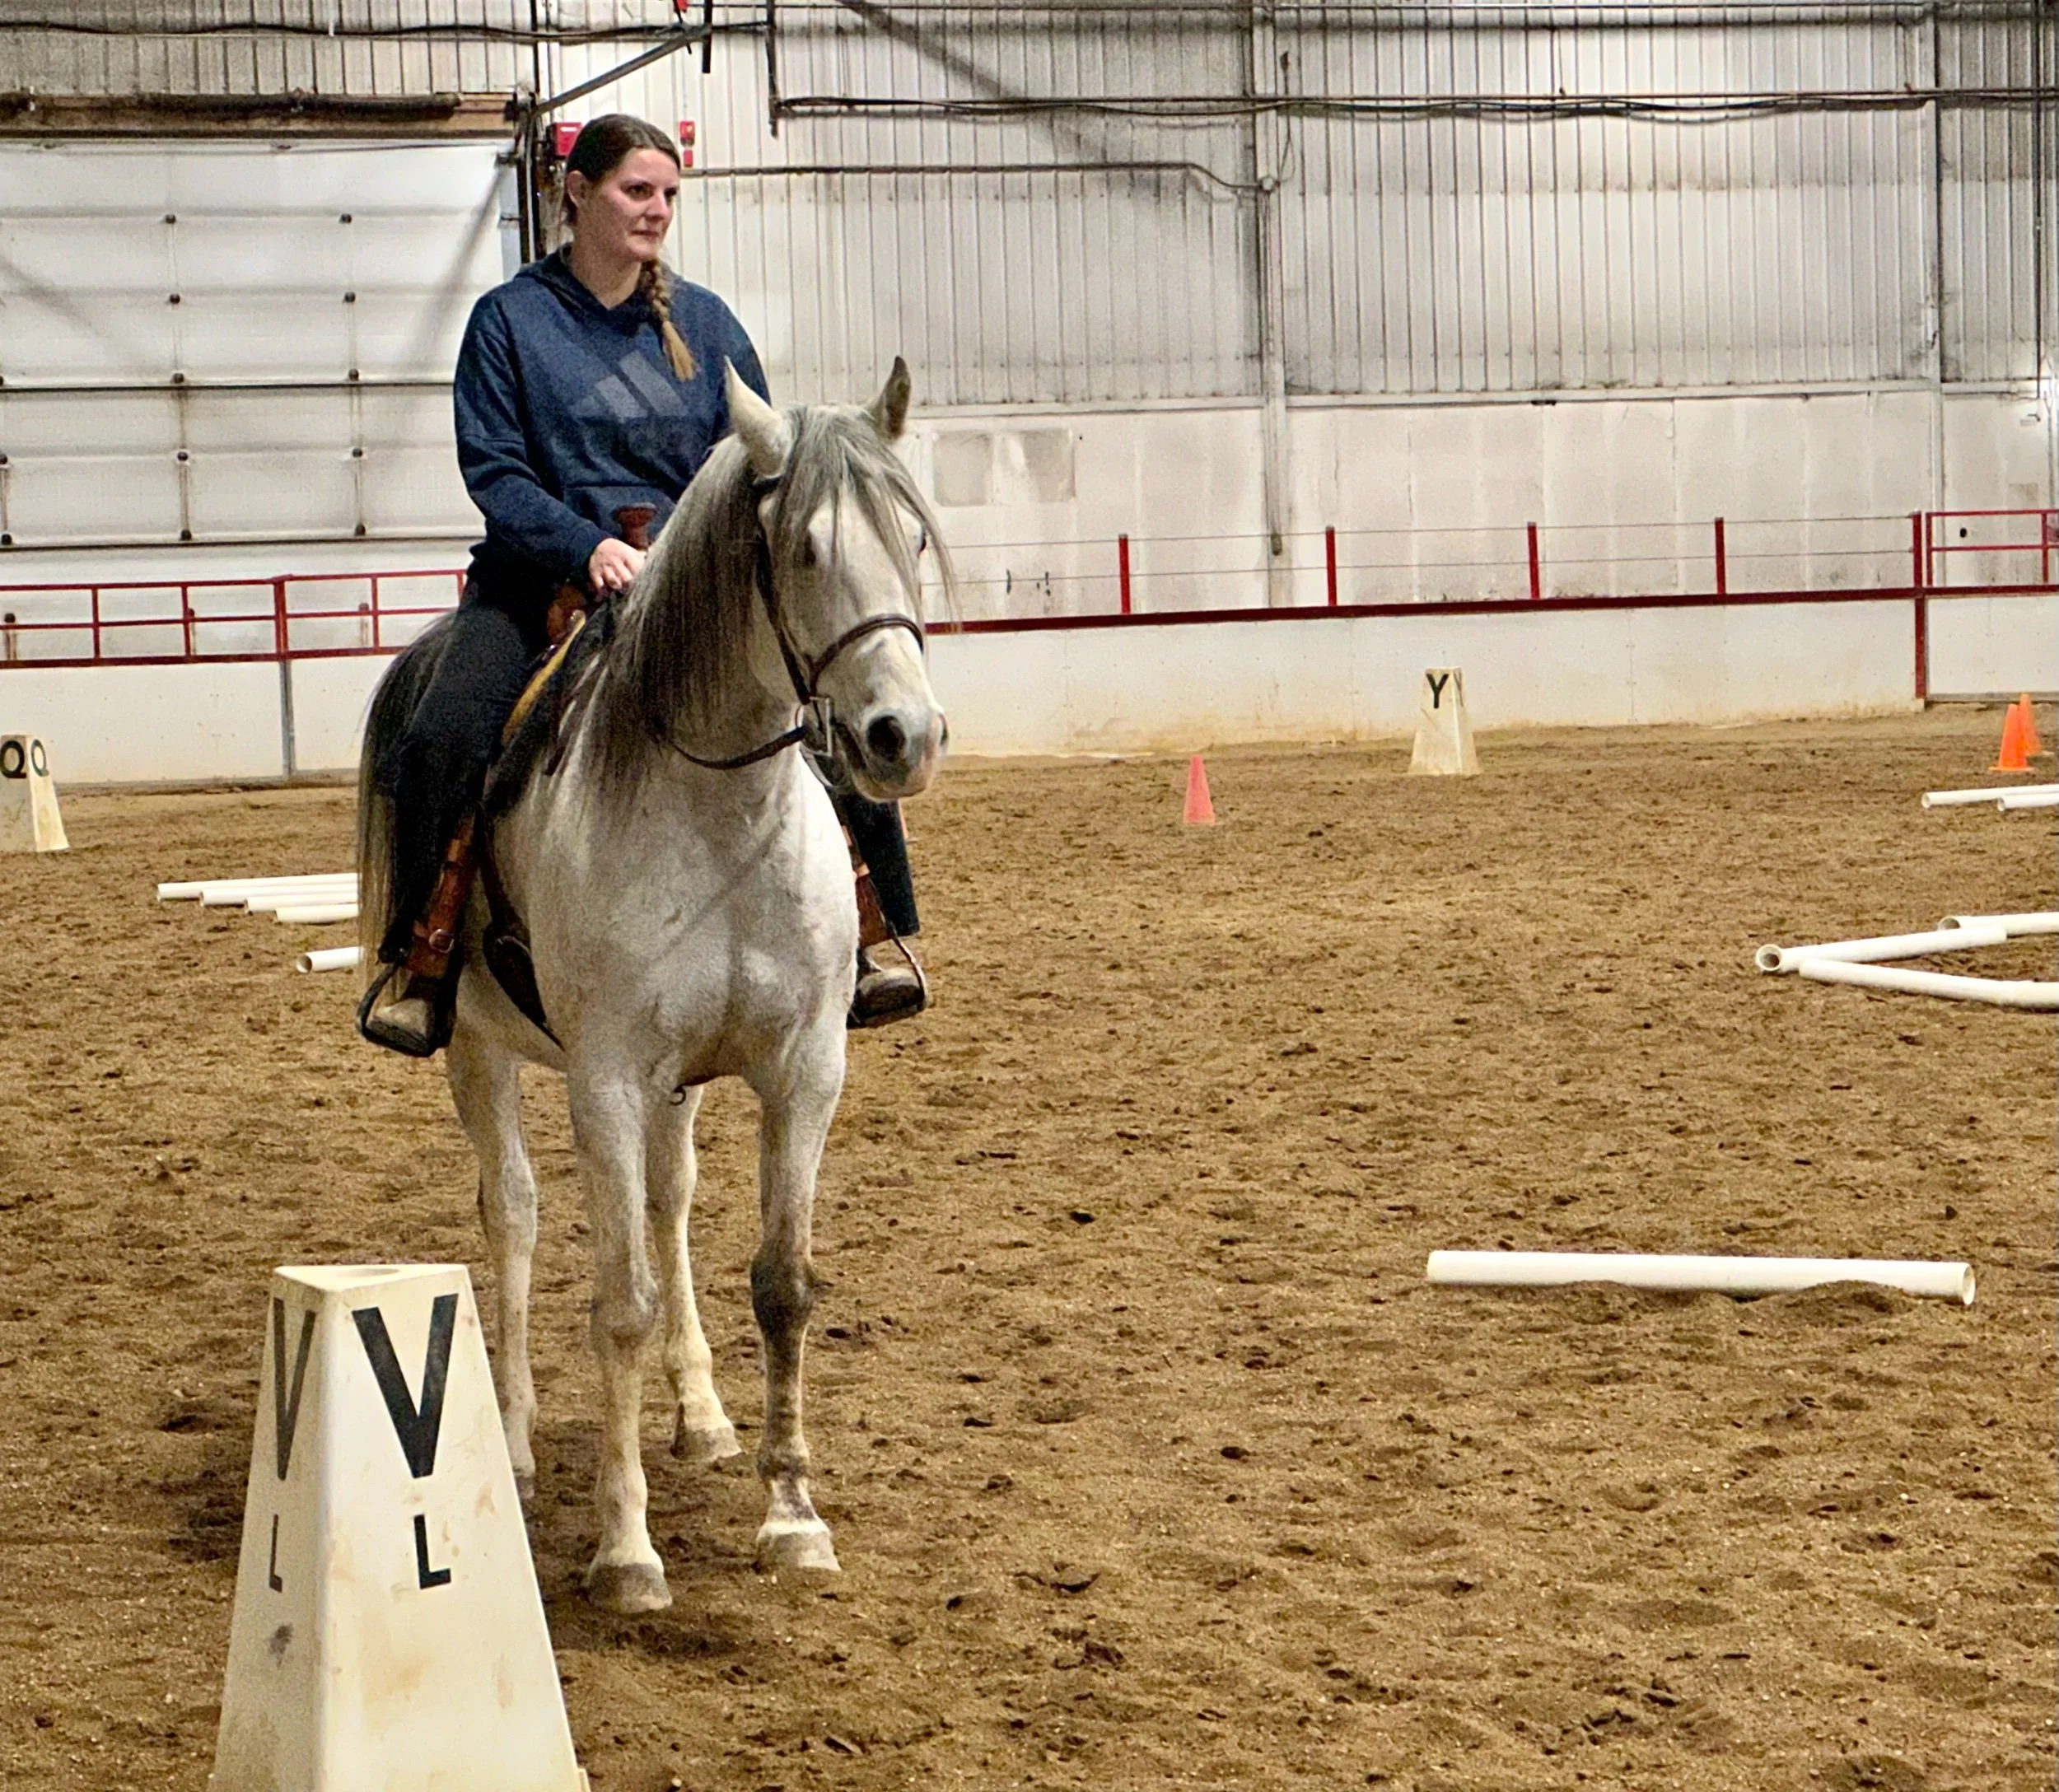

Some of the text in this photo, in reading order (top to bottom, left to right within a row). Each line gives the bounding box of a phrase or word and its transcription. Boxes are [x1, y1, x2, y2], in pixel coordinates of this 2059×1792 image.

[1426, 673, 1450, 709] Y
[0, 740, 27, 778] Q
[31, 739, 49, 777] Q
[273, 1297, 316, 1481] V
[352, 1293, 459, 1479] V
[268, 1514, 282, 1593] L
[413, 1514, 451, 1590] L
